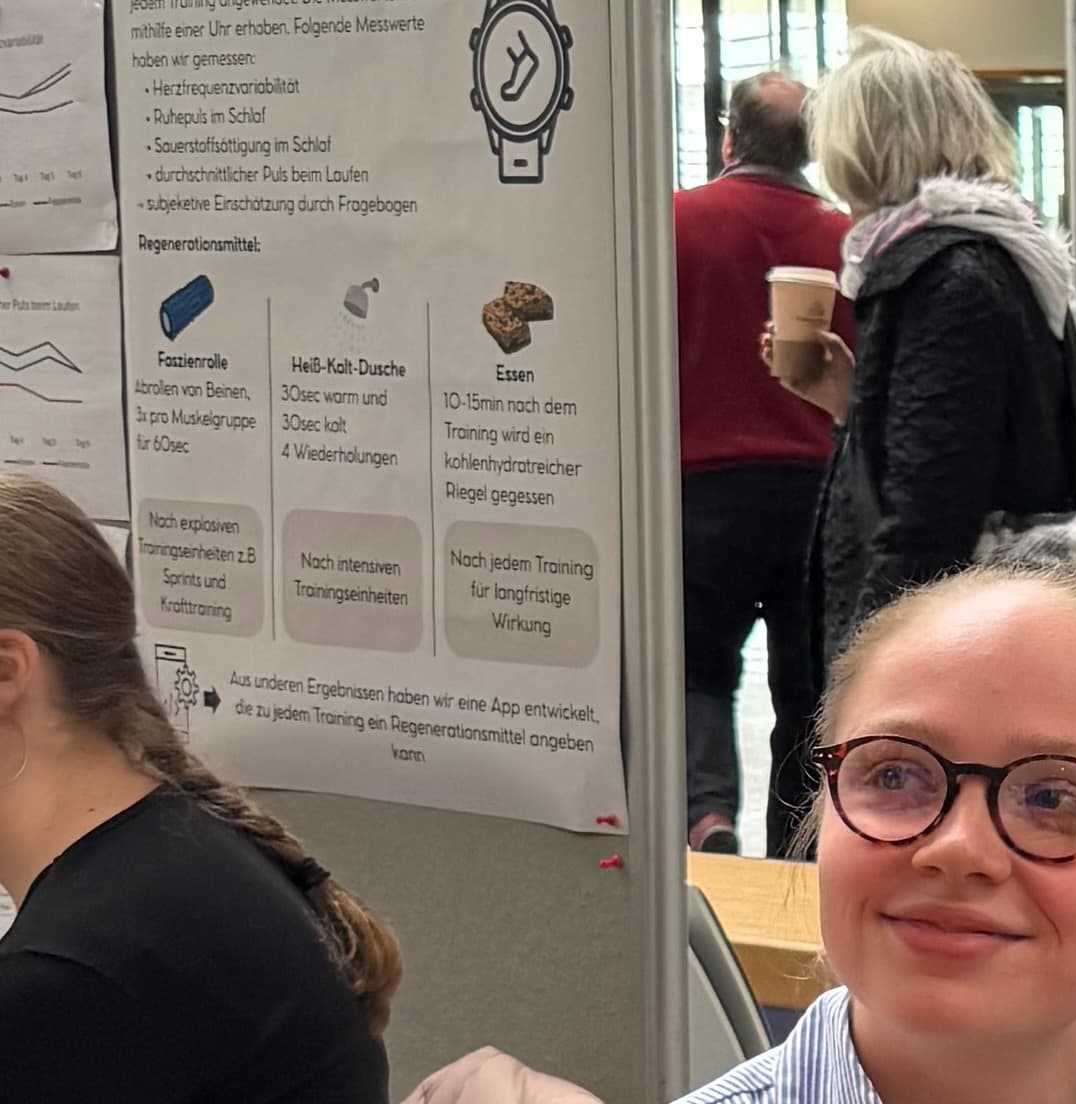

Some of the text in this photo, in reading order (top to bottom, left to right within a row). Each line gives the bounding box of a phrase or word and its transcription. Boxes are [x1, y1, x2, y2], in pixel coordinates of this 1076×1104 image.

[131, 19, 172, 39] mithilfe
[175, 22, 204, 38] einer
[208, 19, 231, 37] Uhr
[293, 17, 352, 38] Folgende
[355, 16, 425, 33] Messwerte
[132, 52, 256, 70] haben wir gemessen:
[153, 78, 300, 98] Herzfrequenzvariabilität
[153, 106, 266, 127] Ruhepuls im Schlaf
[154, 135, 332, 157] Sauerstoffsättigung im Schlaf
[155, 166, 369, 183] durchschnittlicher Puls beim Laufen
[214, 194, 295, 216] Einschätzung
[298, 195, 335, 212] durch
[338, 195, 418, 216] Fragebogen
[138, 234, 261, 254] Regenerationsmittel:
[158, 351, 228, 371] Faszienrolle
[292, 356, 406, 378] Heiß-Kalt-Dusche
[496, 364, 535, 383] Essen
[181, 384, 202, 398] von
[281, 384, 388, 406] 30sec warm und
[443, 392, 577, 416] 10-15min nach dem
[149, 410, 169, 428] pro
[172, 409, 256, 431] Muskelgruppe
[281, 413, 347, 434] 30sec kalt
[444, 421, 554, 445] Training wird ein
[153, 435, 190, 454] 60sec
[281, 442, 398, 469] 4 Wiederholungen
[444, 451, 582, 477] kohlenhydratreicher
[446, 481, 555, 507] Riegel gegessen
[149, 512, 240, 535] Nach explosiven
[138, 537, 234, 563] Trainingseinheiten
[301, 552, 401, 577] Nach intensiven
[450, 549, 594, 580] Nach jedem Training
[162, 568, 226, 590] Sprints und
[294, 579, 408, 606] Trainingseinheiten
[471, 580, 571, 608] für langfristige
[160, 596, 232, 622] Krafttraining
[492, 612, 551, 638] Wirkung
[230, 670, 250, 686] Aus
[307, 677, 384, 701] Ergebnissen
[388, 685, 429, 706] haben
[433, 692, 454, 708] wir
[458, 697, 487, 712] eine
[490, 697, 520, 718] App
[235, 699, 594, 752] die zu jedem Training ein Regenerationsmittel angeben
